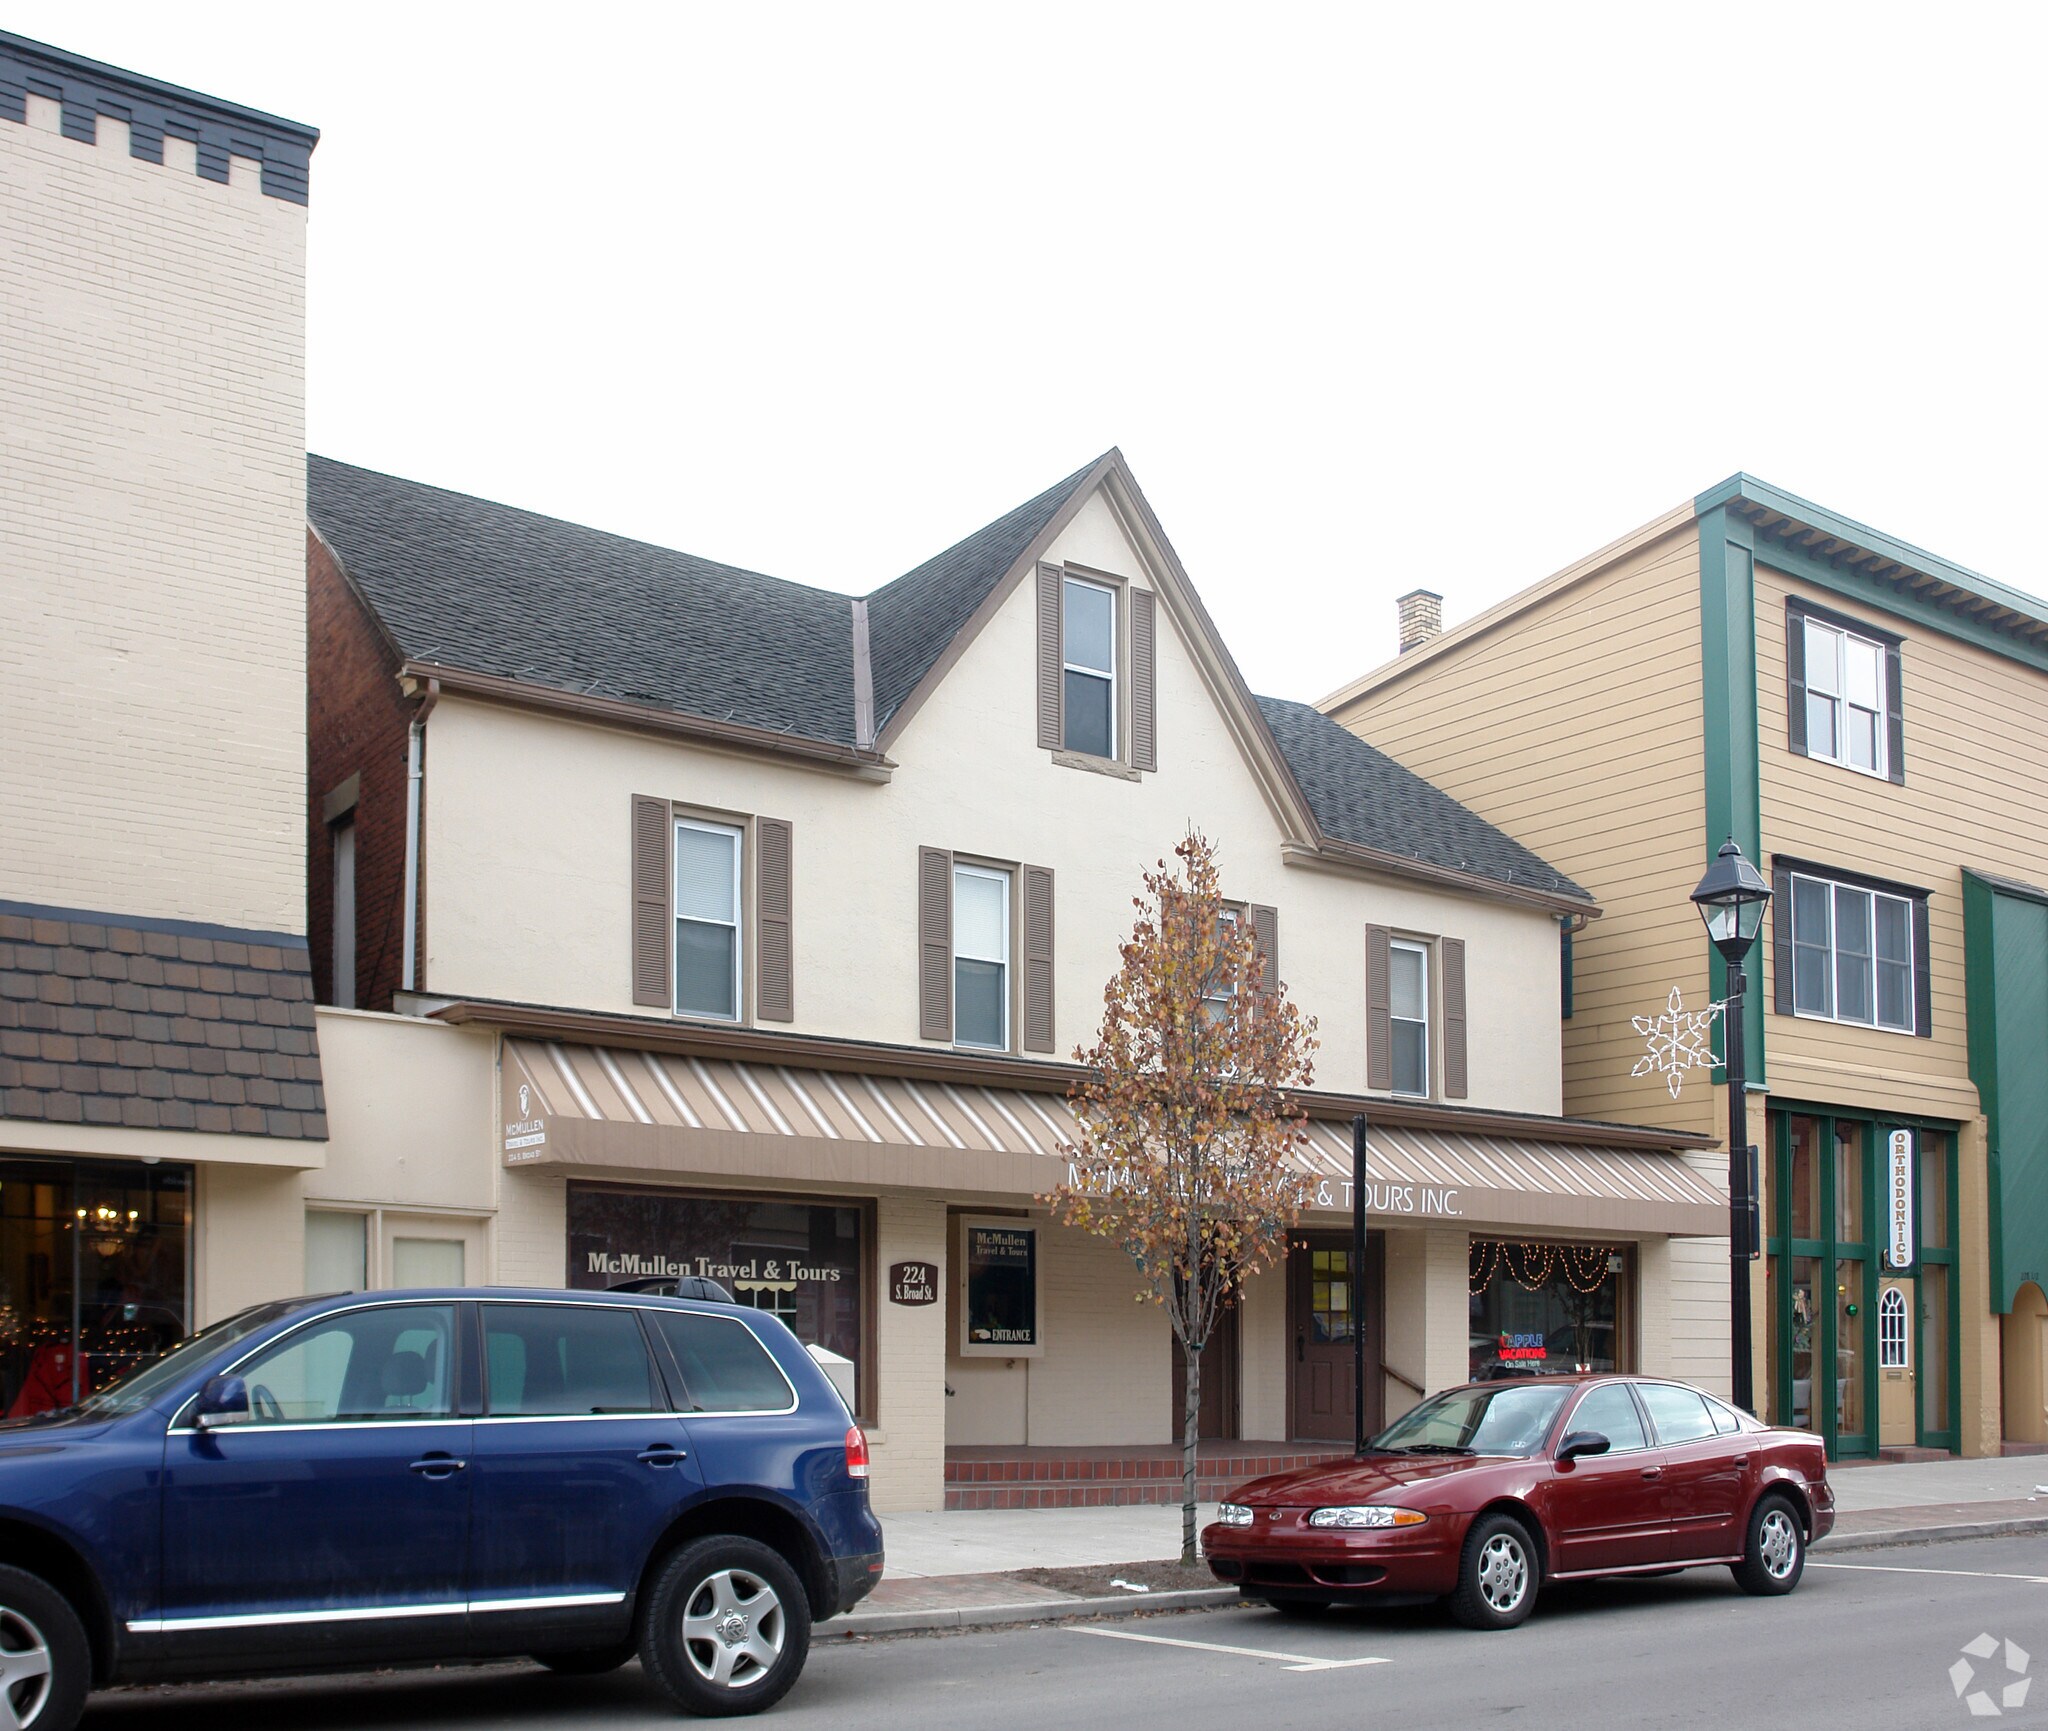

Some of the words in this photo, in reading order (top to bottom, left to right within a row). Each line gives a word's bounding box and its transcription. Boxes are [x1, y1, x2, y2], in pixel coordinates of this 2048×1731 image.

[1317, 1180, 1334, 1207] &
[1421, 1188, 1463, 1216] INC.
[1895, 1133, 1906, 1264] ORTHODONTICS
[977, 1232, 1026, 1246] McMullen
[976, 1245, 999, 1256] Travel
[1000, 1246, 1006, 1256] &
[1008, 1246, 1028, 1257] Tours
[587, 1252, 691, 1276] McMullen
[695, 1256, 757, 1279] Travel
[763, 1260, 781, 1280] &
[786, 1260, 841, 1282] Tours
[902, 1266, 926, 1284] 224
[895, 1284, 903, 1300] S.
[903, 1284, 924, 1300] Broad
[924, 1285, 934, 1301] St.
[992, 1329, 1031, 1342] ENTRANCE
[1507, 1333, 1543, 1348] APPLE
[1498, 1347, 1547, 1360] VACATIONS
[1505, 1360, 1514, 1369] On
